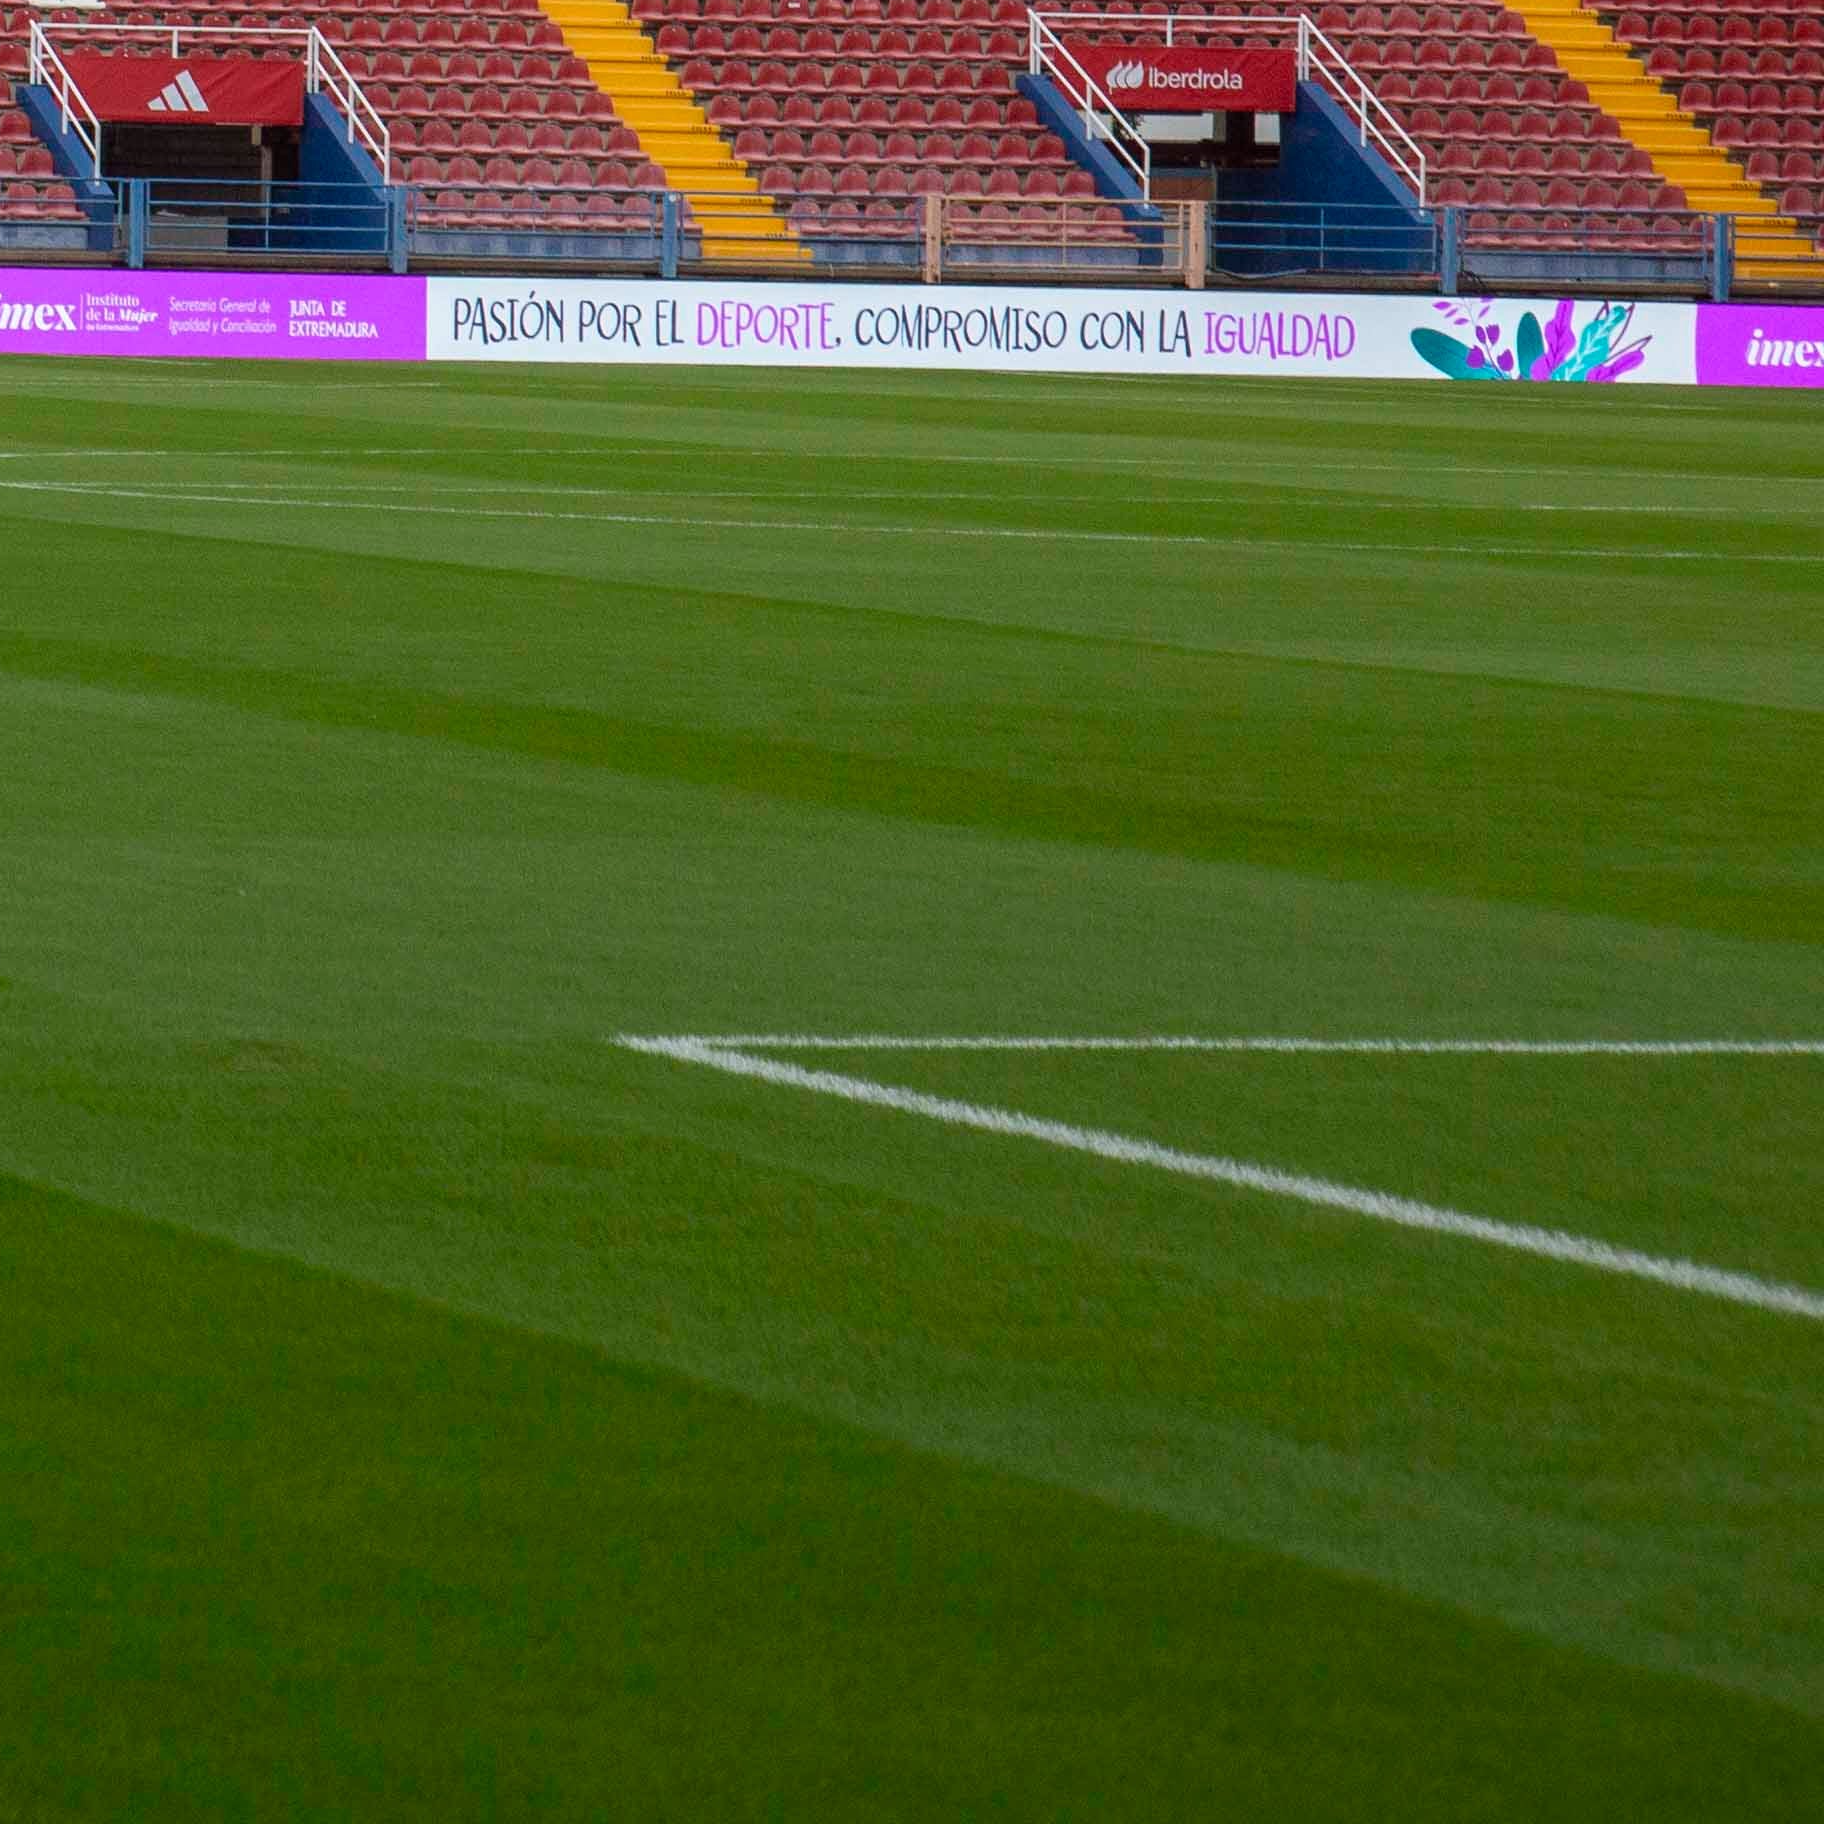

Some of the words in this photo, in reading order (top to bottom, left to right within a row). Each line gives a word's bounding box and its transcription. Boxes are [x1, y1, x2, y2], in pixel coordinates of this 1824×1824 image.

[1148, 66, 1244, 90] Iberdrola
[85, 291, 140, 307] Instituto
[289, 299, 326, 318] JUNTA
[331, 299, 347, 317] DE
[85, 307, 101, 322] de
[103, 307, 115, 322] la
[118, 308, 159, 325] Mujer
[453, 290, 565, 345] PASIÓN
[578, 299, 642, 347] POR
[655, 299, 684, 347] EL
[697, 300, 842, 351] DEPORTE,
[854, 303, 1068, 353] COMPROMISO
[1079, 309, 1146, 354] CON
[1158, 309, 1192, 359] LA
[1203, 310, 1357, 361] IGUALDAD
[288, 320, 379, 339] EXTREMADURA
